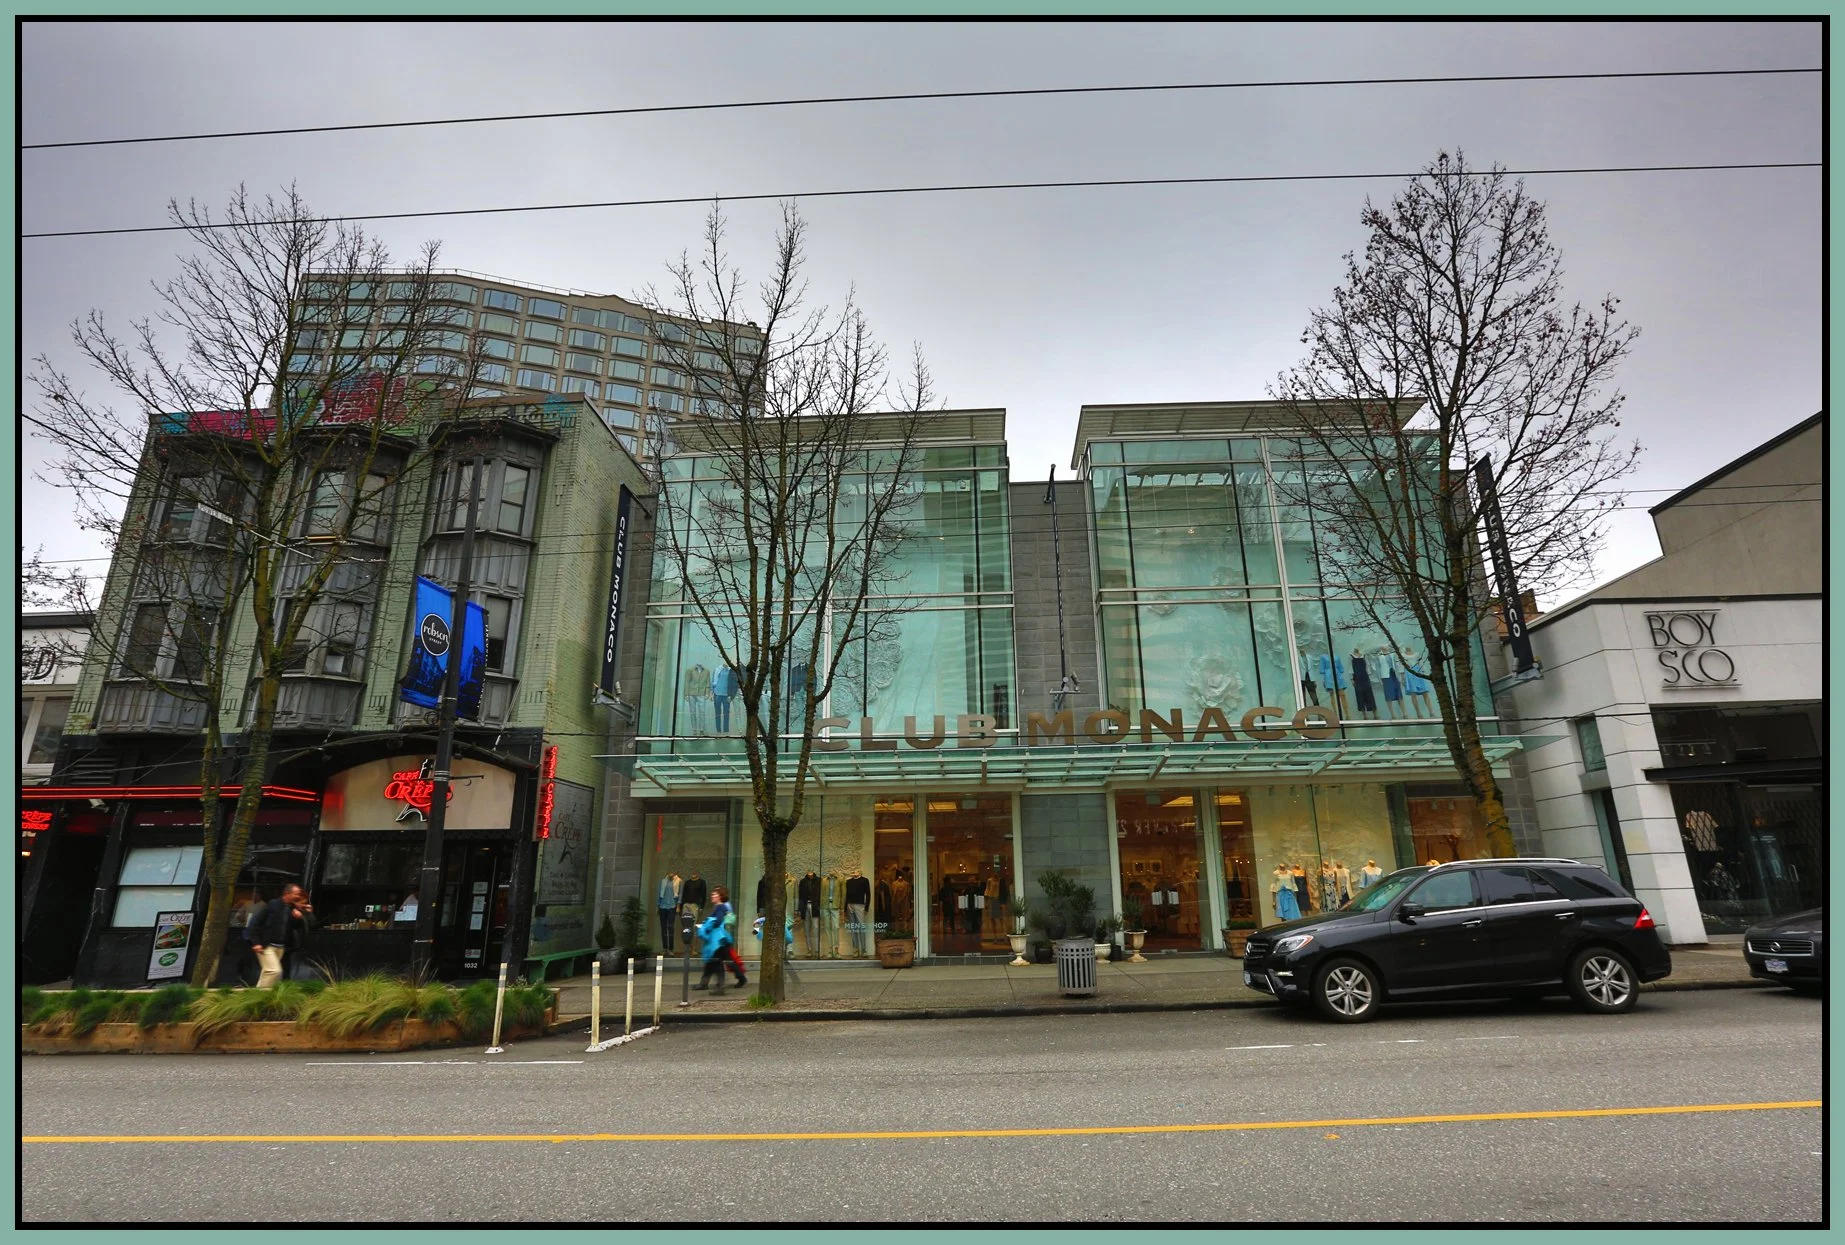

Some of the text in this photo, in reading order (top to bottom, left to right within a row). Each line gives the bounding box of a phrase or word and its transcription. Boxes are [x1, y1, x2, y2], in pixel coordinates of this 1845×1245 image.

[606, 516, 626, 663] CLUB MONACO
[423, 622, 449, 644] robson
[1646, 613, 1716, 647] BOY
[811, 705, 1342, 751] CLUB MONACO
